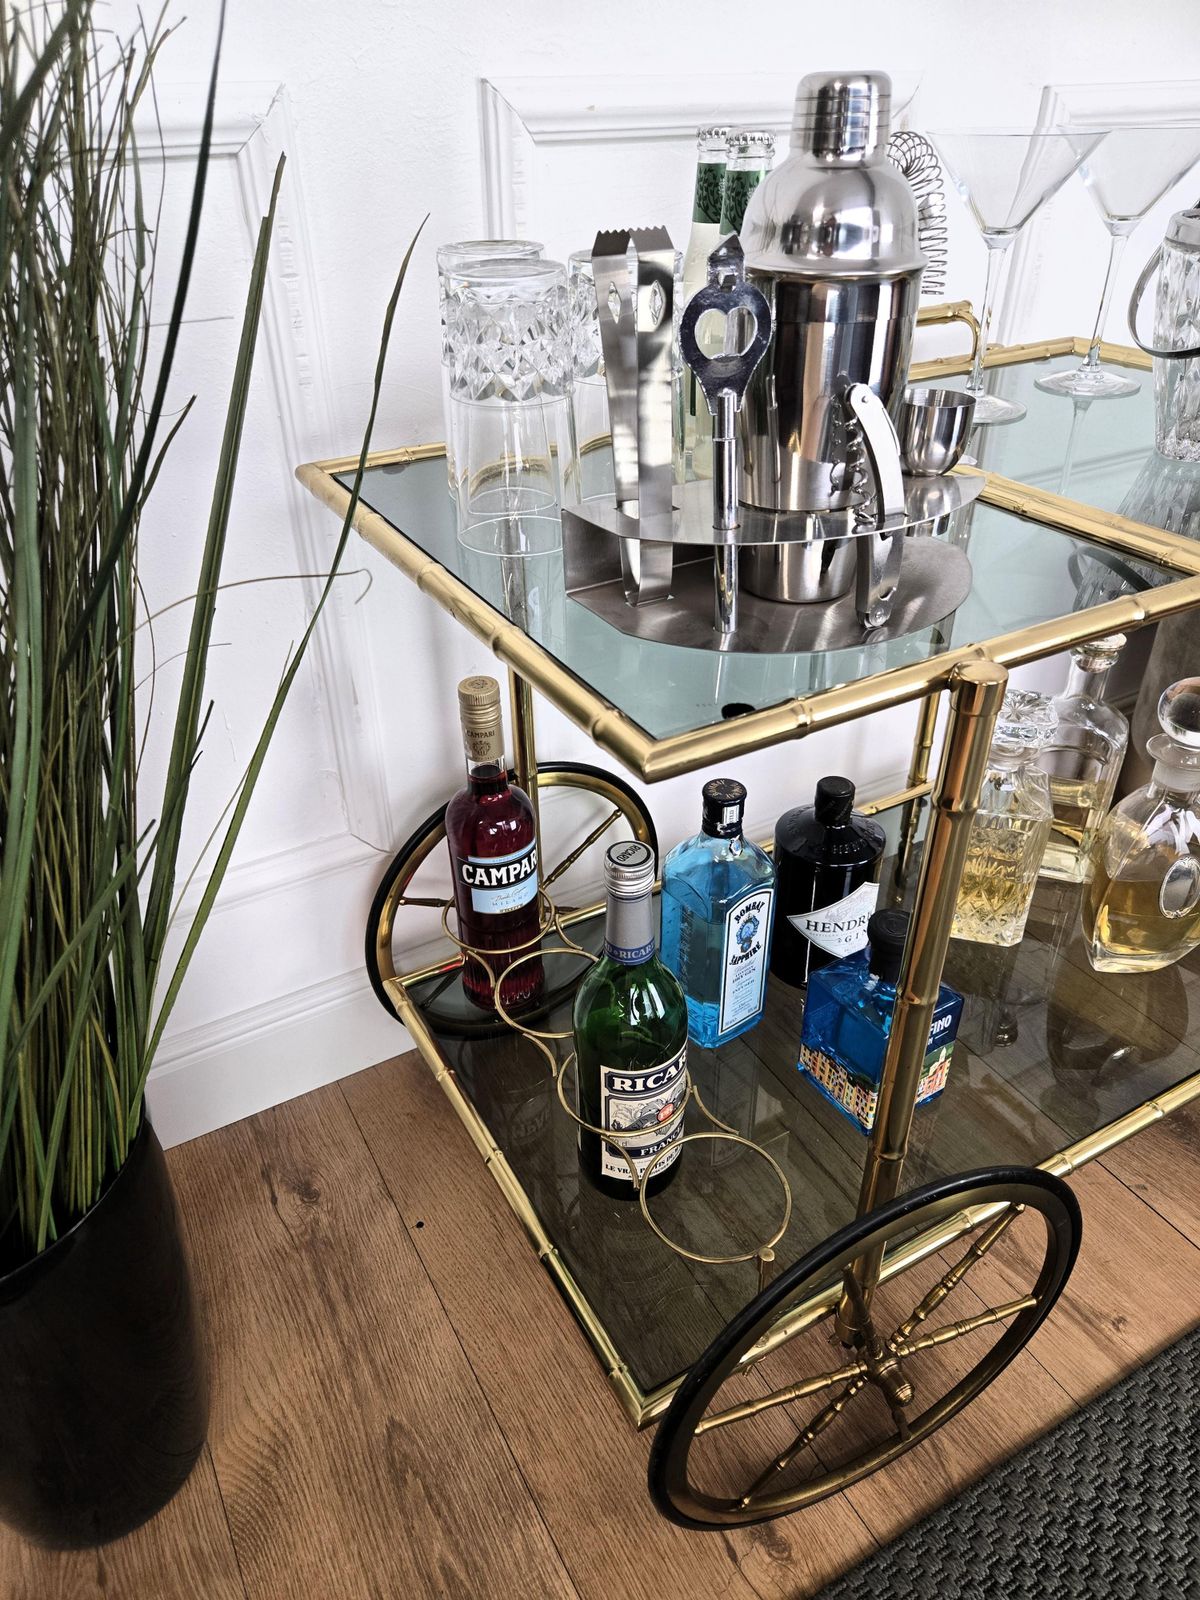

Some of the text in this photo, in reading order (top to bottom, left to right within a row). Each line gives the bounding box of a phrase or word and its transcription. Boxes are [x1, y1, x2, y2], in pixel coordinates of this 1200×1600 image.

[466, 730, 495, 738] CAMPARI
[616, 844, 642, 862] RICARD
[461, 849, 537, 886] CAMPAR
[734, 901, 766, 924] BOMBAY
[619, 942, 655, 959] RICAR
[729, 941, 761, 966] SAPPHIRE
[612, 1050, 686, 1091] RICAR
[605, 1163, 616, 1172] LE
